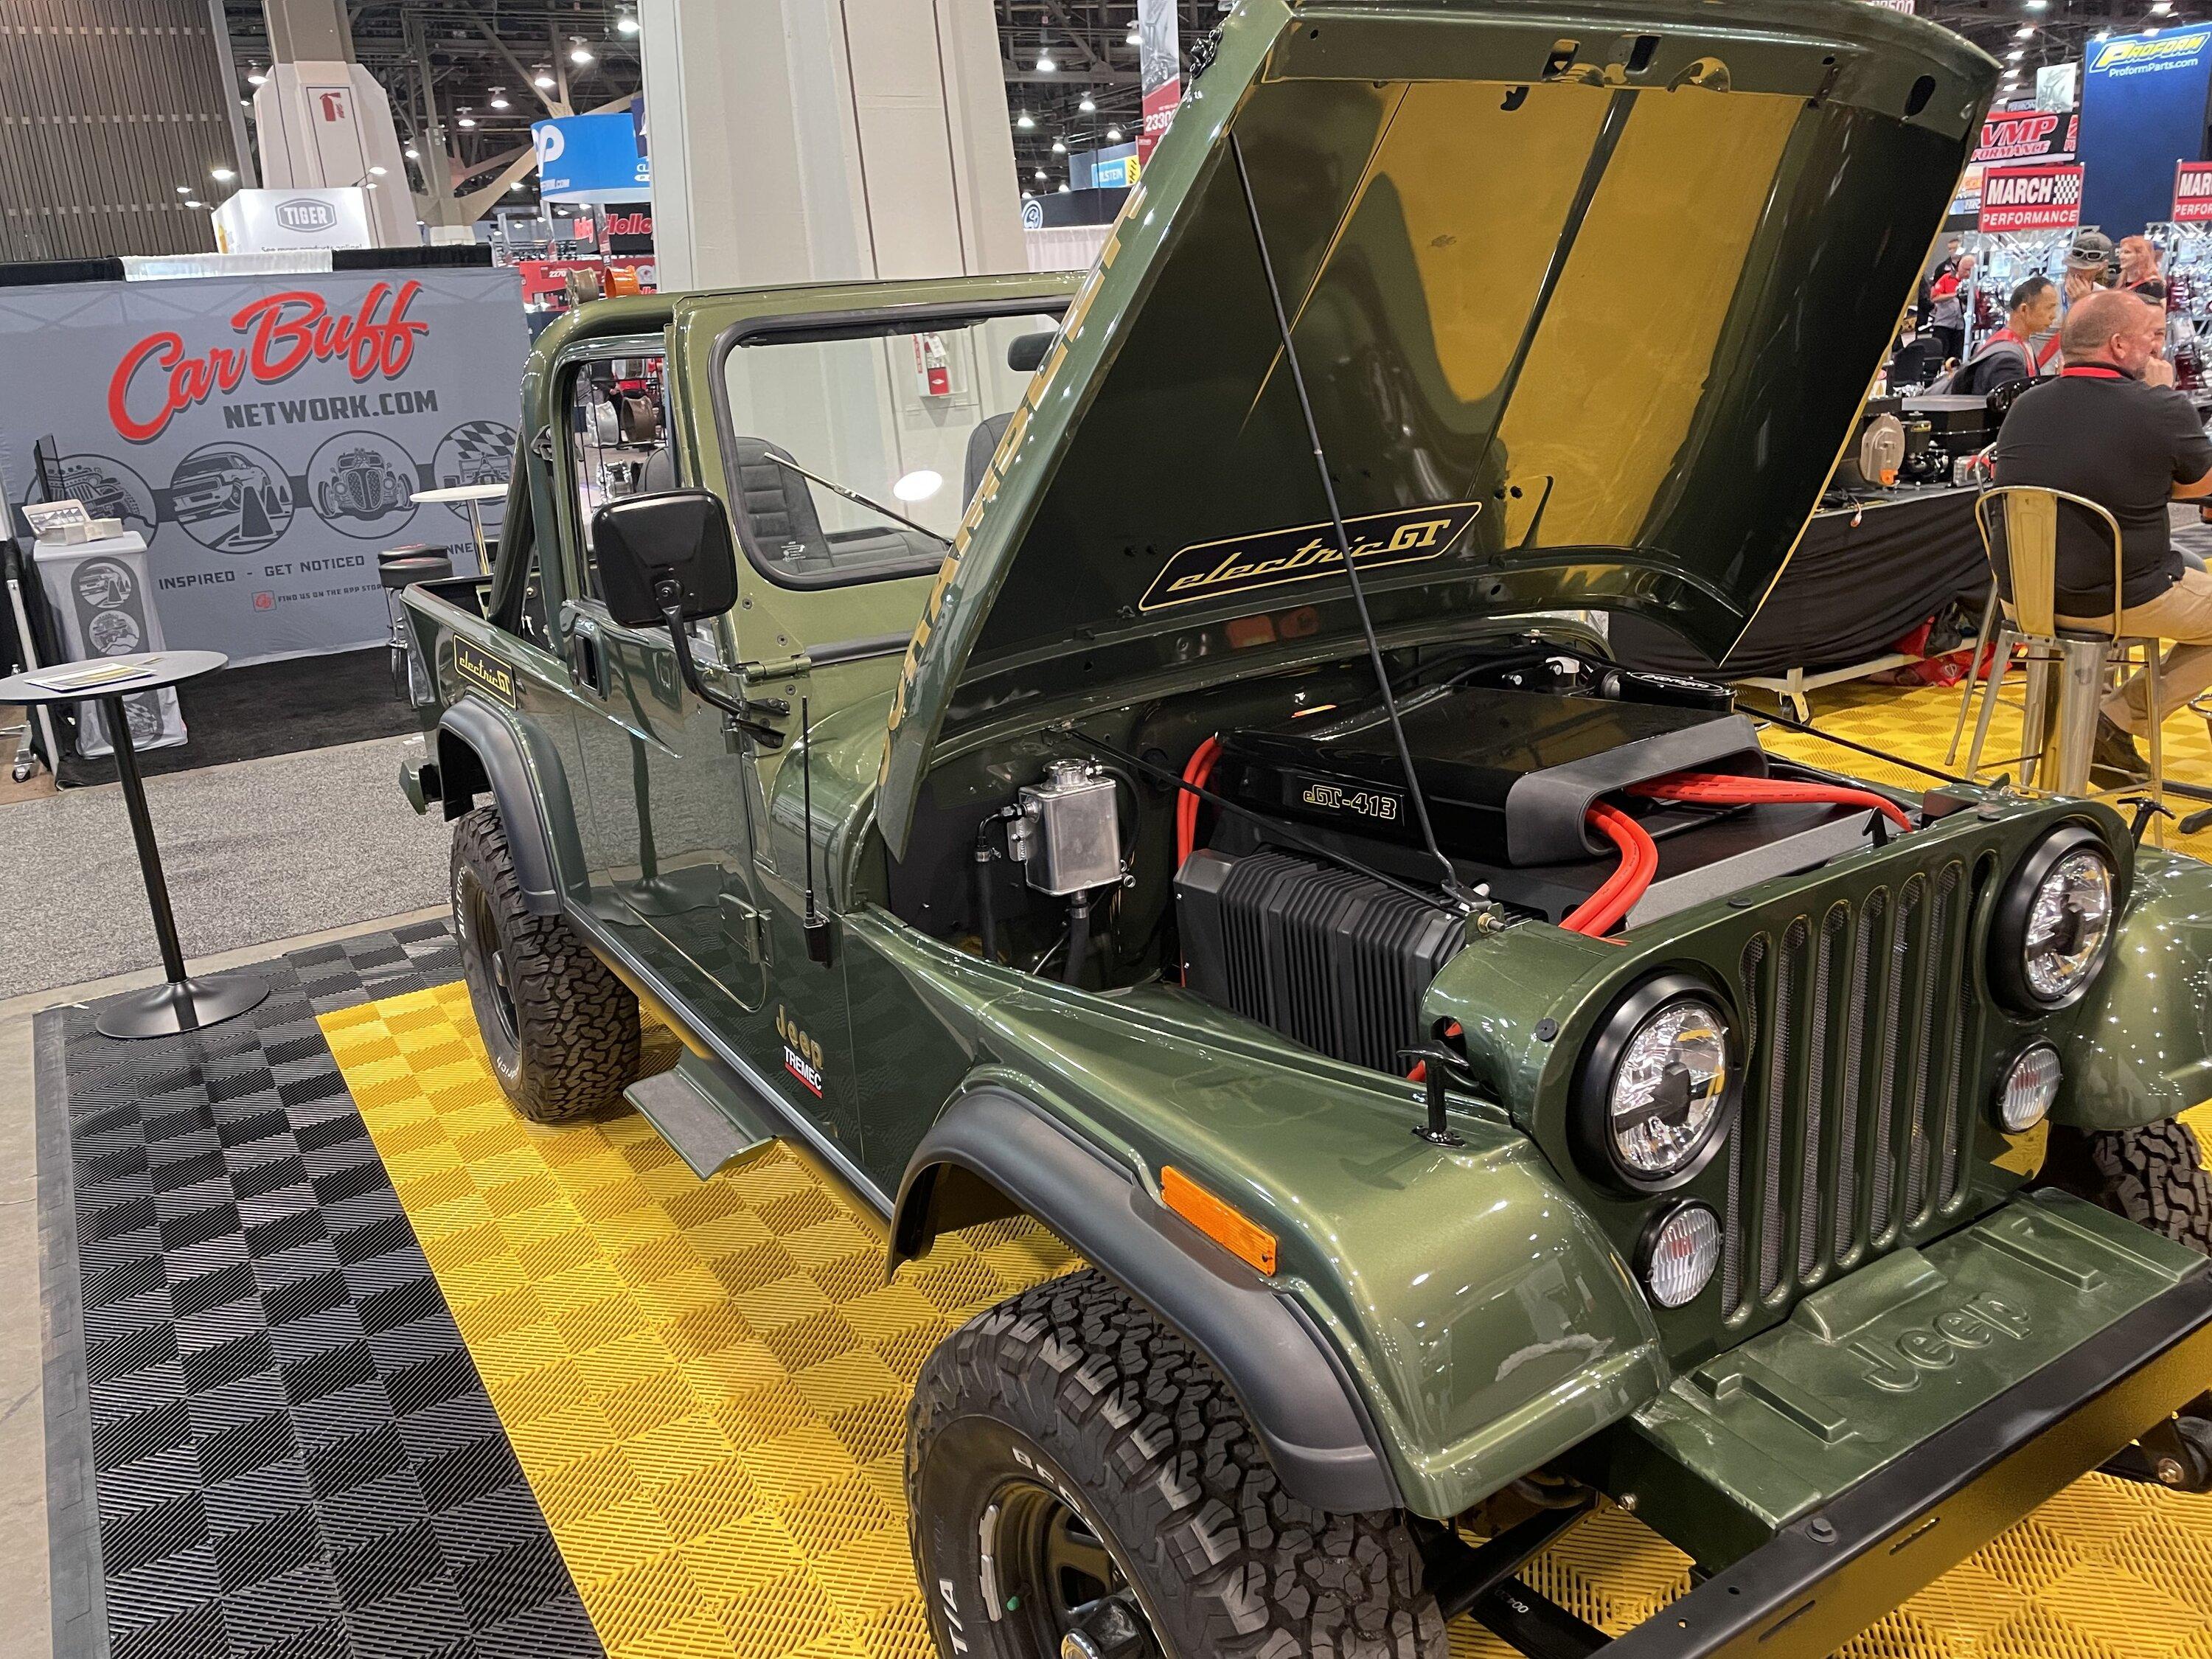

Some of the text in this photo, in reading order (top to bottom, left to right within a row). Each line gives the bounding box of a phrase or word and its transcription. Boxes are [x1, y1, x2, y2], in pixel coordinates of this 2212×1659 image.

[2109, 58, 2199, 77] ProformParts.com
[1980, 116, 2059, 147] VMP
[1969, 140, 2052, 161] FORMANCE
[1986, 178, 2053, 205] MARCH
[2179, 173, 2212, 196] MAR
[283, 206, 328, 225] TIGER
[1982, 209, 2079, 226] PERFORMANCE
[223, 389, 439, 429] NETWORK.COM
[159, 570, 235, 590] INSPIRED
[265, 564, 293, 577] GET
[301, 555, 365, 572] NOTICED
[313, 589, 324, 598] ON
[362, 583, 382, 592] STOR
[459, 651, 512, 696] electricGT
[1304, 785, 1397, 820] eGT-413
[776, 1004, 824, 1070] Jeep
[783, 1045, 822, 1091] TREMEC
[1847, 1291, 2033, 1392] Jeep
